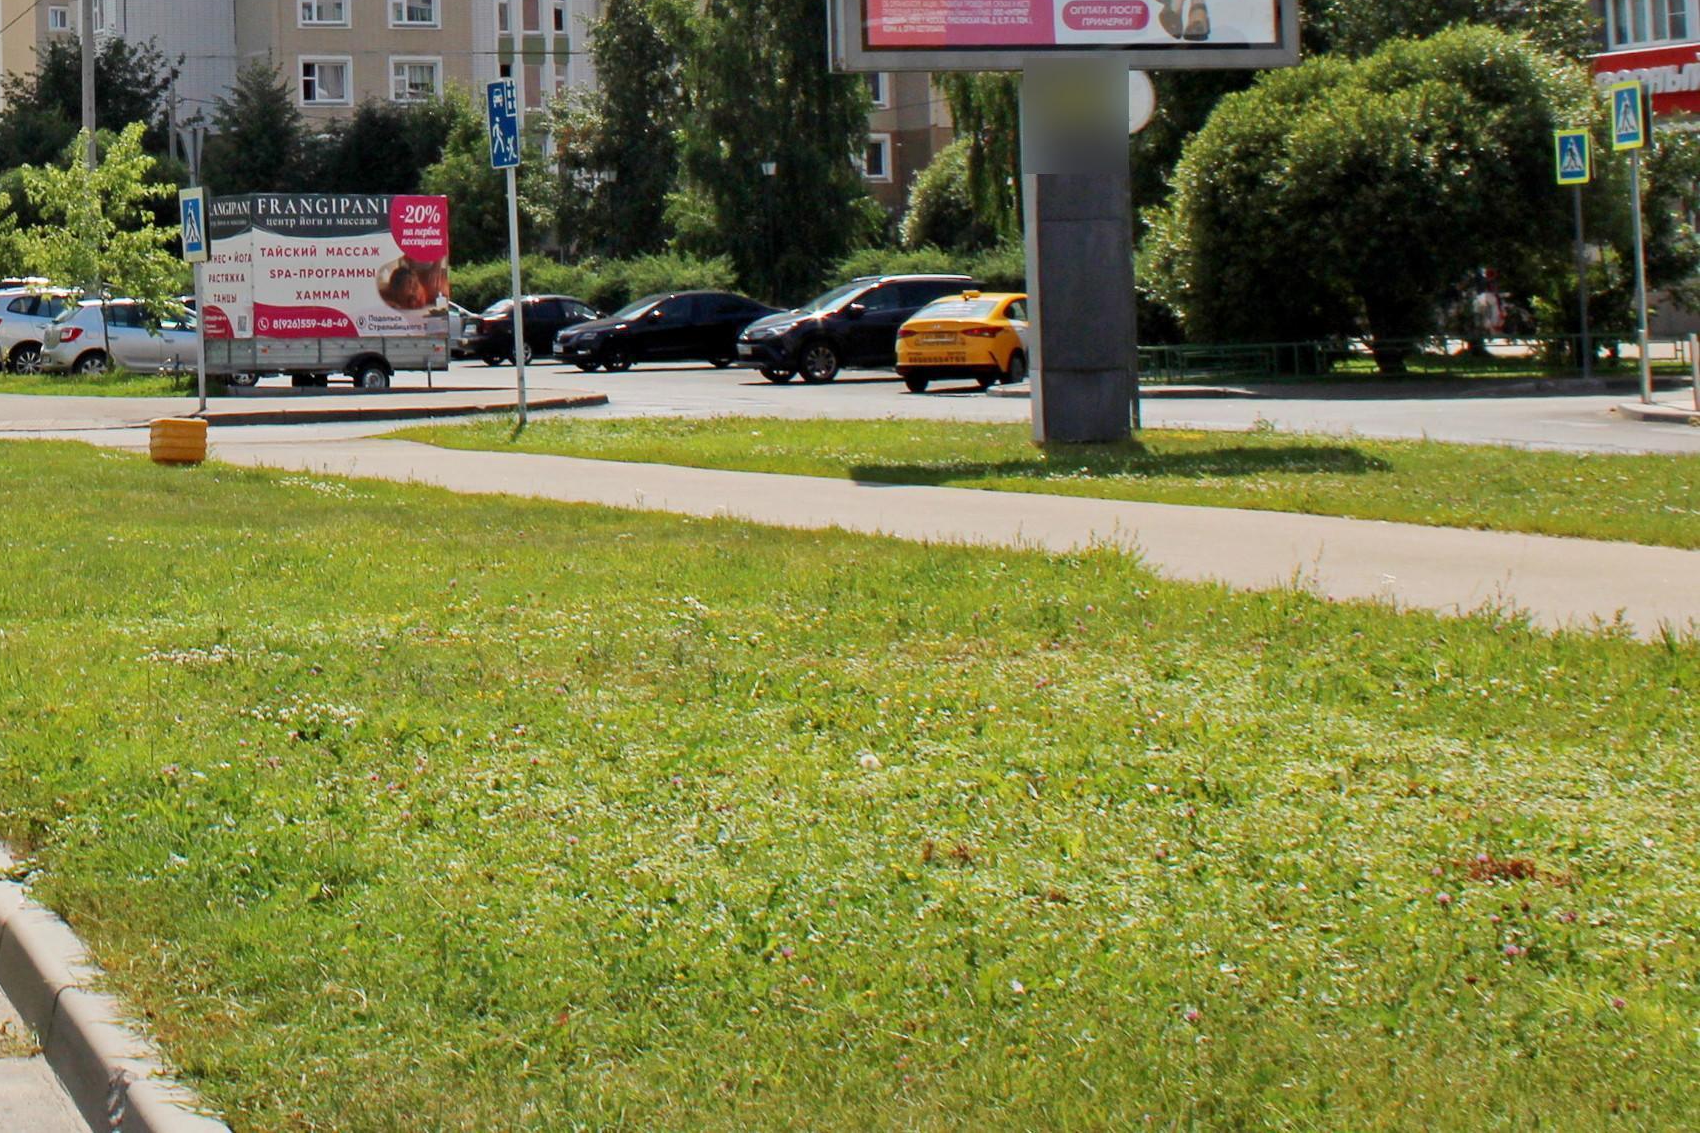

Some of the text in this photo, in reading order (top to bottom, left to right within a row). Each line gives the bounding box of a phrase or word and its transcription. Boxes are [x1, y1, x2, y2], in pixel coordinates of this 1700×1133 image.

[1070, 6, 1142, 15] ОПЛАТА ПОСЛЕ
[1082, 18, 1132, 26] ПРИМЕРКИ
[257, 198, 388, 214] FRANGIPANI
[399, 205, 441, 224] -20%
[266, 218, 296, 227] центр
[300, 216, 323, 226] йоги
[414, 226, 440, 238] первое
[401, 239, 442, 248] посещение
[260, 246, 380, 257] ТАЙСКИЙ МАССАЖ
[234, 252, 252, 264] ЙОГА
[208, 273, 245, 283] РАСТЯЖКА
[269, 268, 376, 279] SPA-ПРОГРАММЫ
[213, 293, 237, 303] ТАНЦЫ
[296, 290, 350, 300] ХАММАМ
[272, 319, 348, 330] 8(926)559-48-49
[368, 315, 402, 324] Подольск
